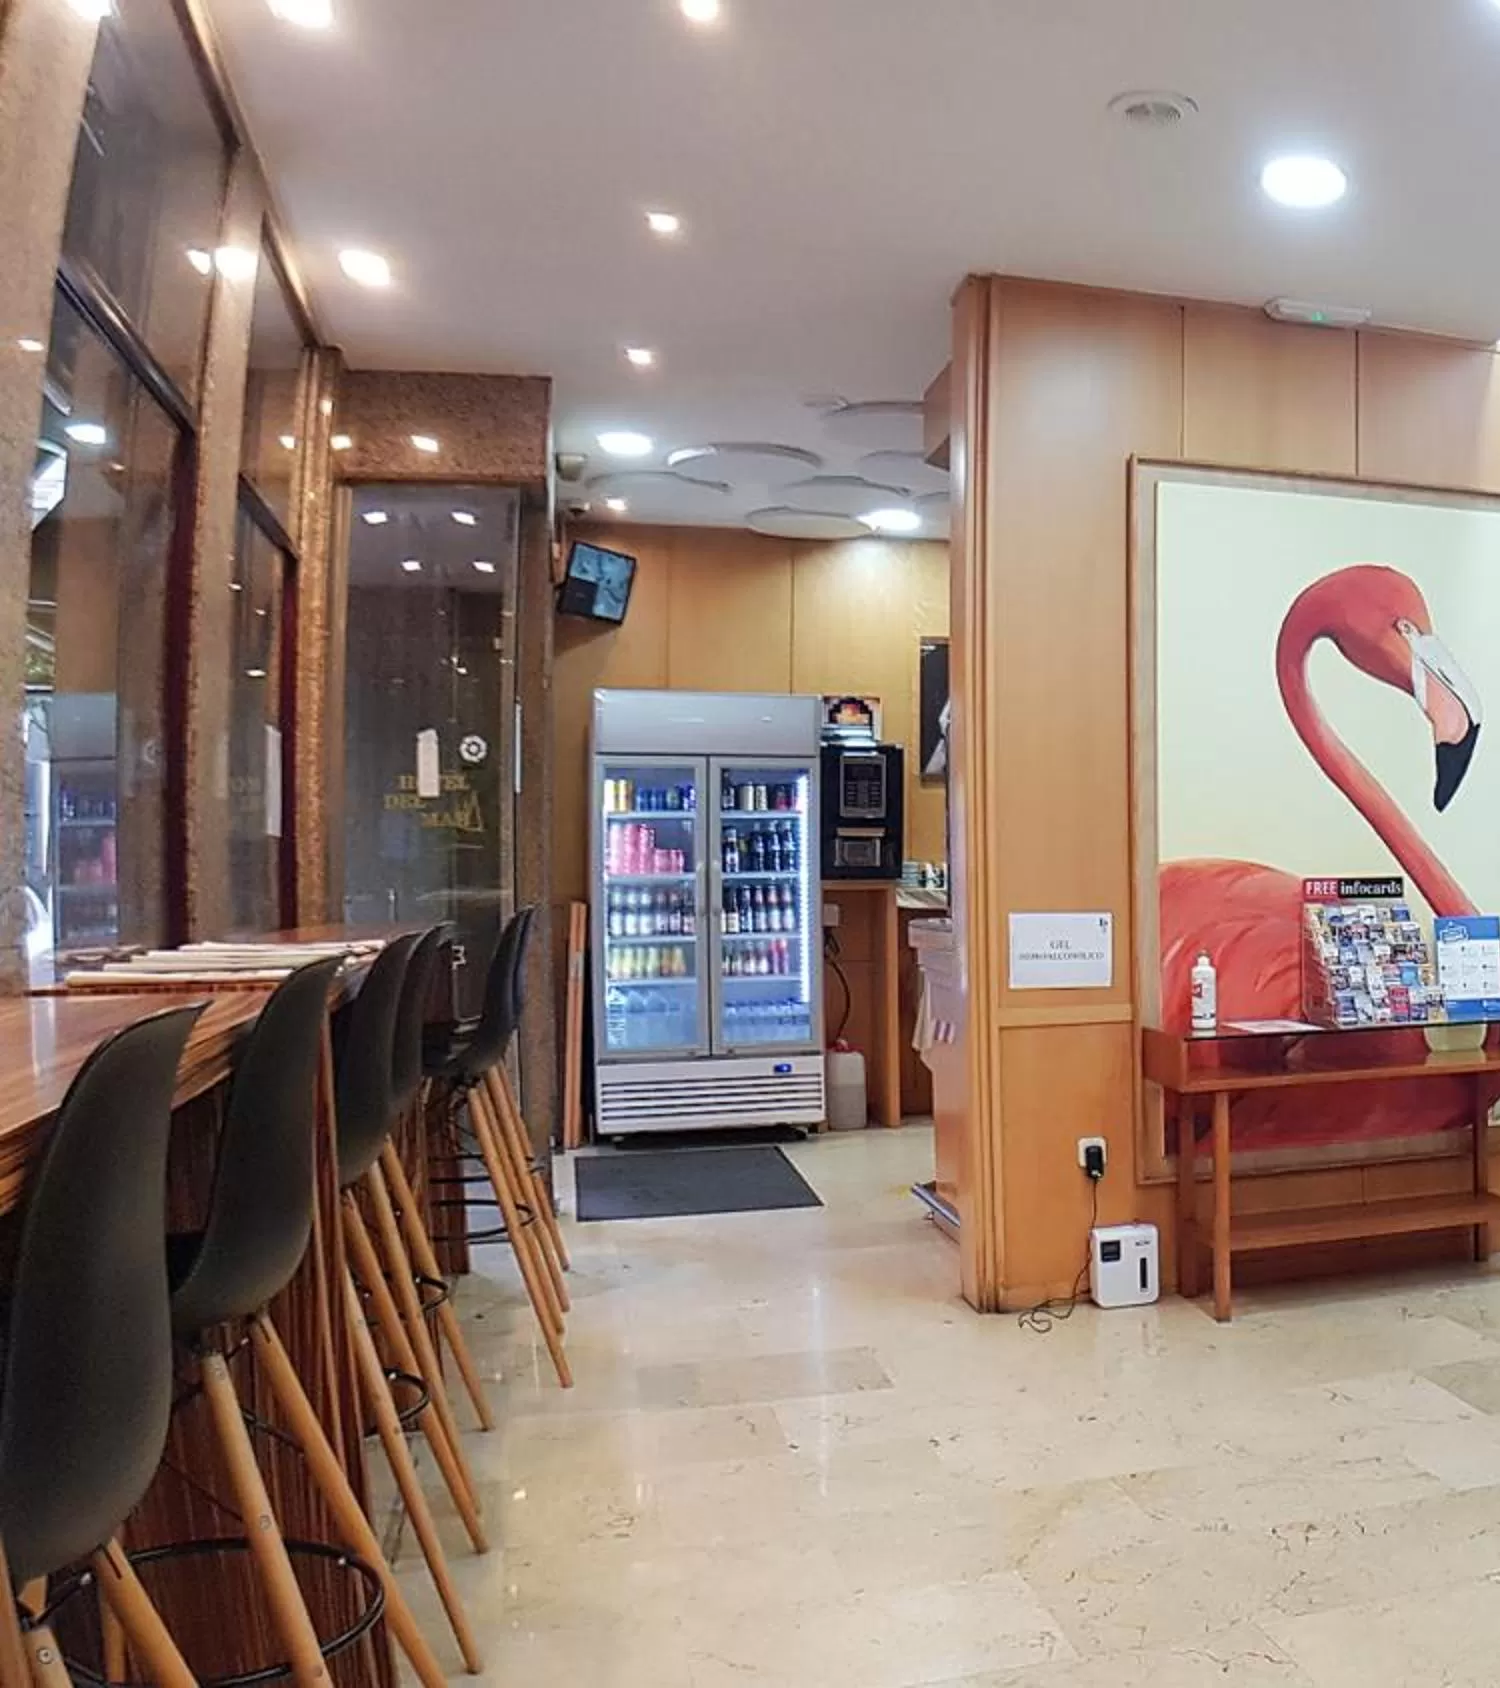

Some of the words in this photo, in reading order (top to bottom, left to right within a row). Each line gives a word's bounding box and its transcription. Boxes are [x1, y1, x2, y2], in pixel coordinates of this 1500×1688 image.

[399, 774, 470, 791] HEL
[1305, 881, 1337, 895] FREE
[1341, 880, 1402, 895] infocards
[1049, 939, 1072, 950] GEL
